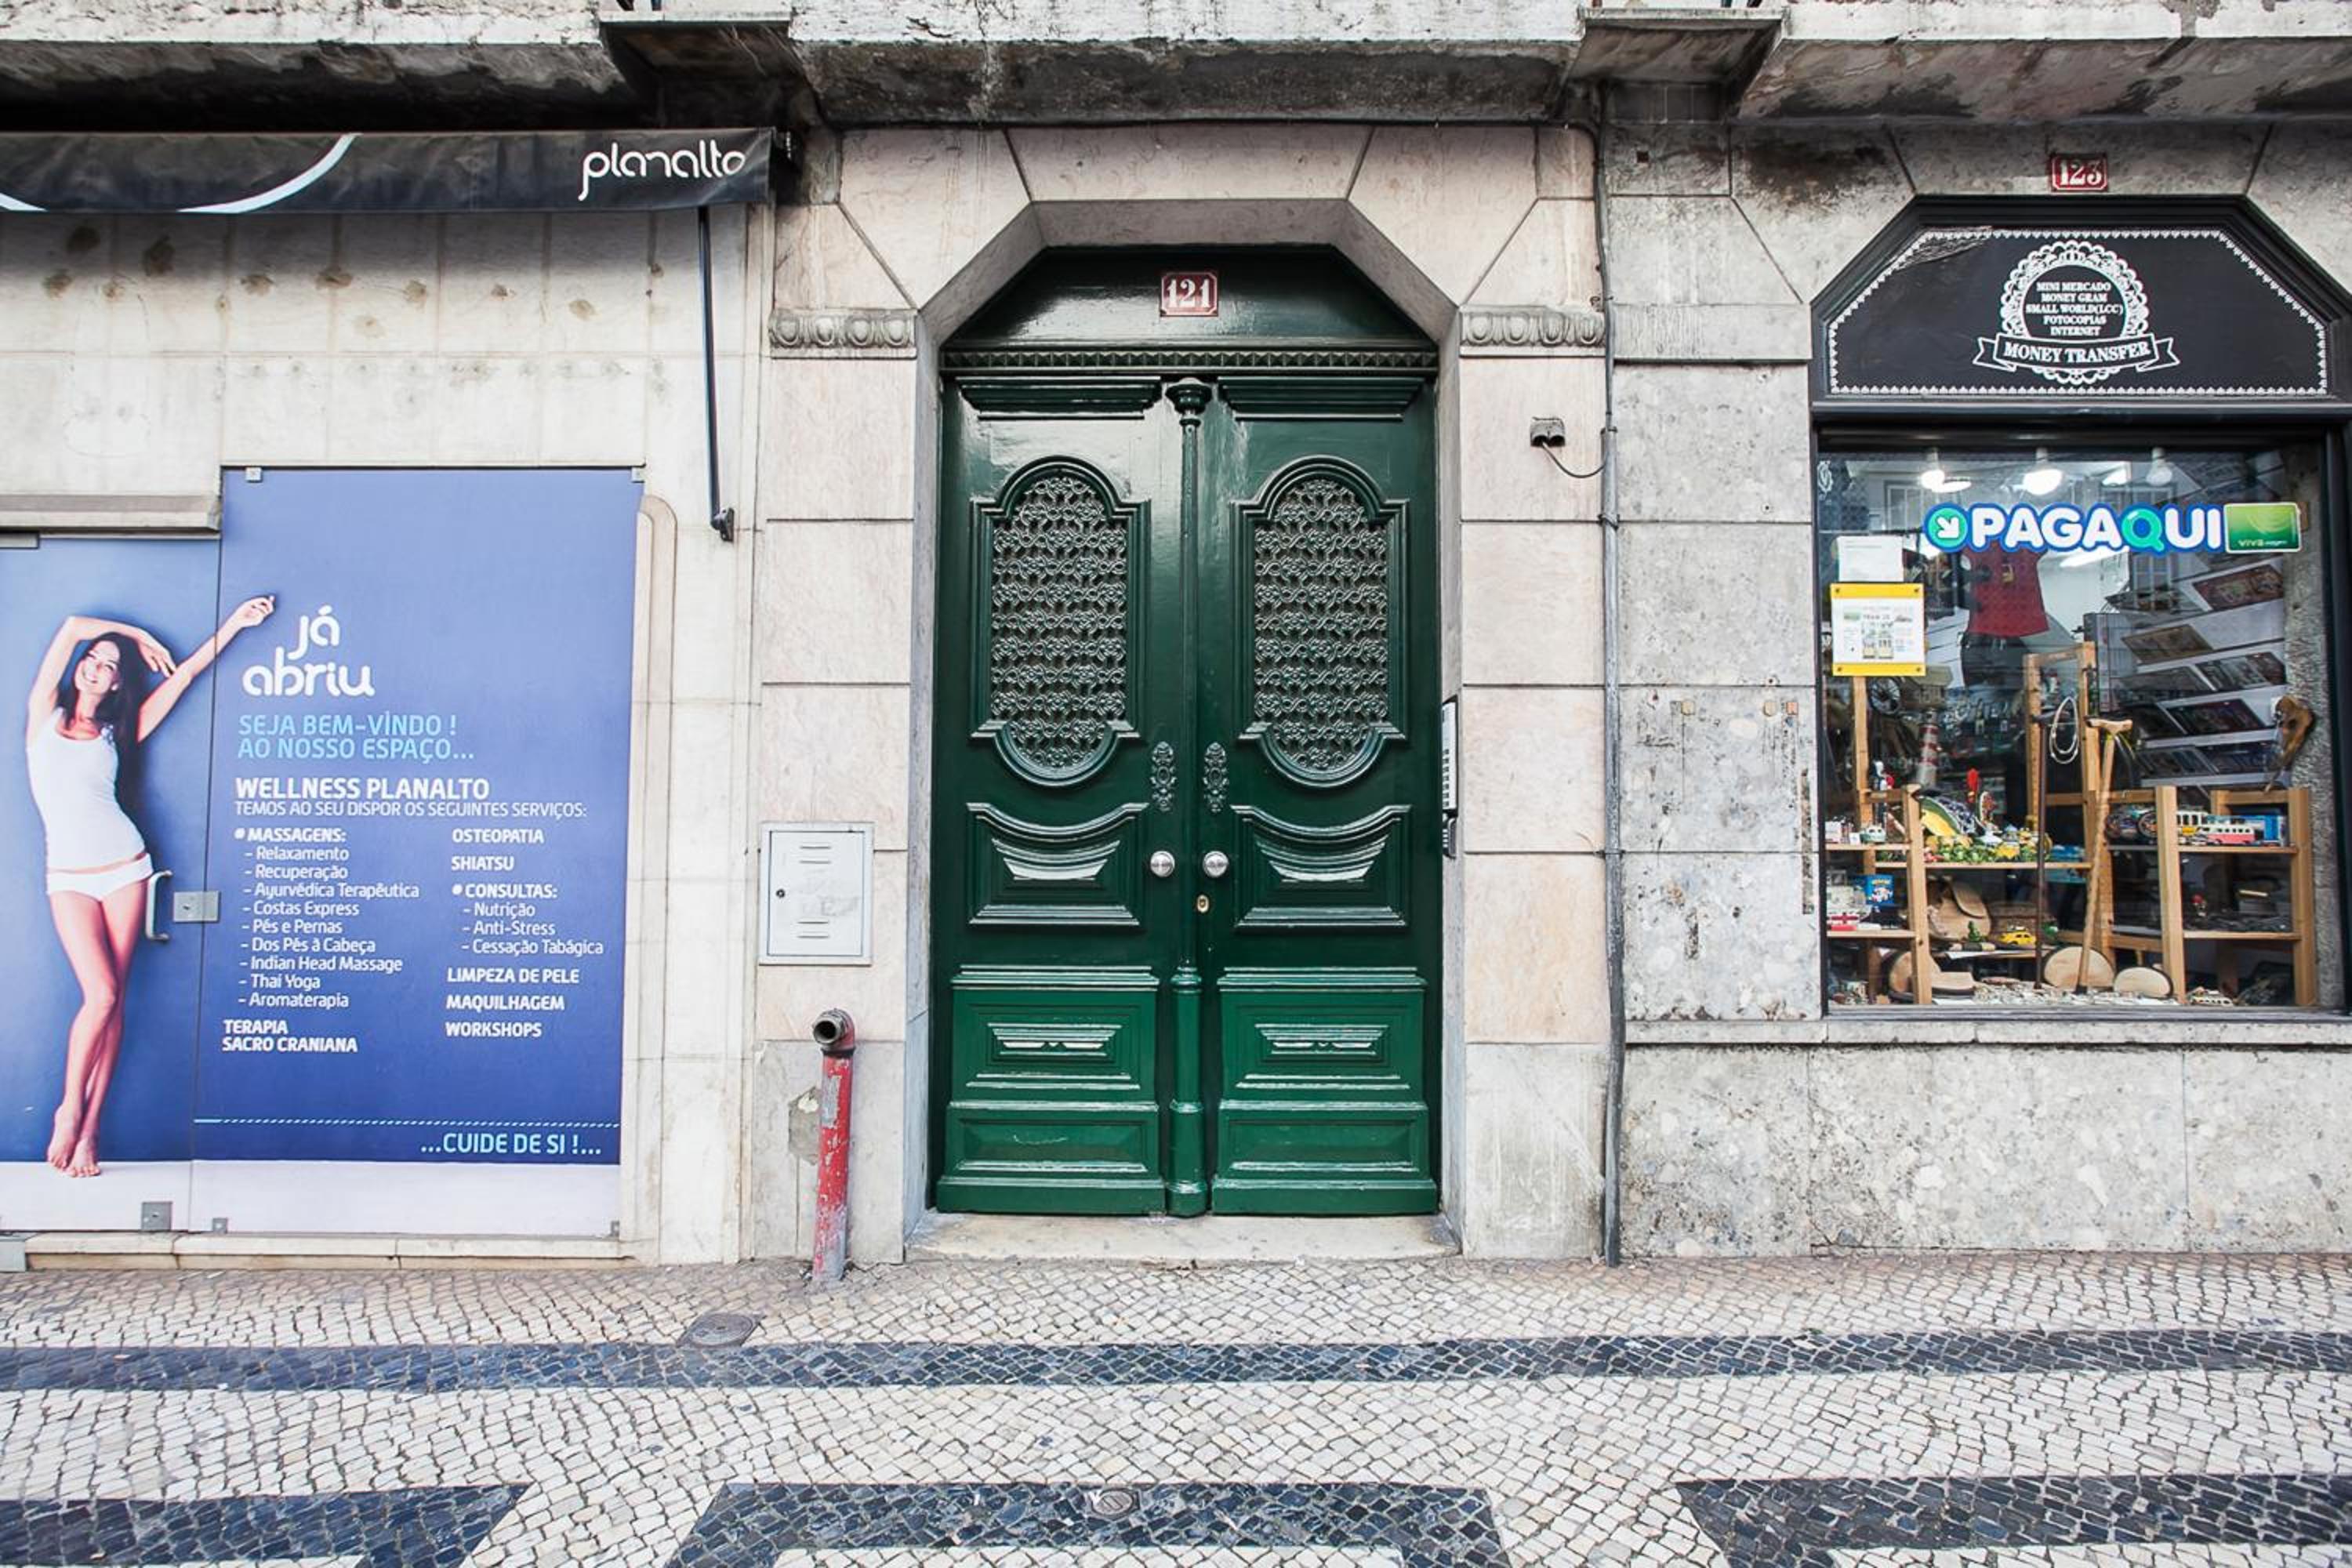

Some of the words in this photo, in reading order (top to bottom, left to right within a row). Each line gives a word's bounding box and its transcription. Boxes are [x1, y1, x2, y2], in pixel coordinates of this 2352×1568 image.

[578, 140, 745, 201] planalto
[2060, 159, 2102, 186] 123
[1167, 278, 1210, 308] 121
[2036, 282, 2060, 292] MINI
[2061, 282, 2111, 292] MERCADO
[2041, 293, 2076, 303] MONEY
[2078, 293, 2107, 303] GRAM
[2026, 304, 2058, 314] SMALL
[2044, 315, 2107, 325] FOTOCOPIAS
[2050, 326, 2101, 336] INTERNET
[2004, 341, 2063, 363] MONEY
[2064, 341, 2151, 363] TRANSFER
[1970, 506, 2222, 552] PAGAQUI
[287, 604, 340, 661] já
[242, 648, 375, 697] abriu
[238, 714, 296, 735] SEJA
[238, 738, 270, 759] AO
[278, 738, 355, 759] NOSSO
[235, 778, 360, 799] WELLNESS
[366, 778, 490, 800] PLANALTO
[235, 801, 286, 817] TEMOS
[289, 801, 312, 817] AO
[315, 801, 344, 817] SEU
[347, 801, 401, 817] DISPOR
[405, 801, 425, 817] OS
[428, 802, 509, 818] SEGUINTES
[512, 802, 587, 822] SERVIÇOS:
[247, 828, 347, 842] MASSAGENS:
[452, 829, 544, 844] OSTEOPATIA
[256, 846, 349, 860] Relaxamento
[255, 864, 348, 881] Recuperação
[451, 856, 514, 871] SHIATSU
[254, 882, 335, 900] Ayurvédica
[338, 883, 420, 901] Terapêutica
[465, 884, 557, 898] CONSULTAS:
[253, 901, 302, 916] Costas
[304, 901, 360, 919] Express
[474, 902, 535, 920] Nutrição
[252, 919, 279, 934] Pés
[281, 923, 292, 934] e
[294, 919, 343, 934] Pernas
[474, 920, 556, 935] Anti-Stress
[252, 938, 280, 952] Dos
[323, 938, 376, 956] Cabeça
[473, 939, 538, 957] Cessação
[542, 939, 604, 958] Tabágica
[250, 956, 296, 971] Indian
[299, 956, 336, 971] Head
[339, 957, 403, 975] Massage
[285, 974, 321, 992] Yoga
[447, 967, 515, 983] LIMPEZA
[519, 968, 539, 983] DE
[542, 968, 580, 984] PELE
[249, 993, 350, 1010] Aromaterapia
[446, 994, 565, 1014] MAQUILHAGEM
[223, 1019, 289, 1034] TERAPIA
[445, 1022, 543, 1037] WORKSHOPS
[222, 1036, 274, 1051] SACRO
[277, 1037, 358, 1053] CRANIANA
[514, 1134, 542, 1154] DE
[546, 1134, 565, 1155] SI
